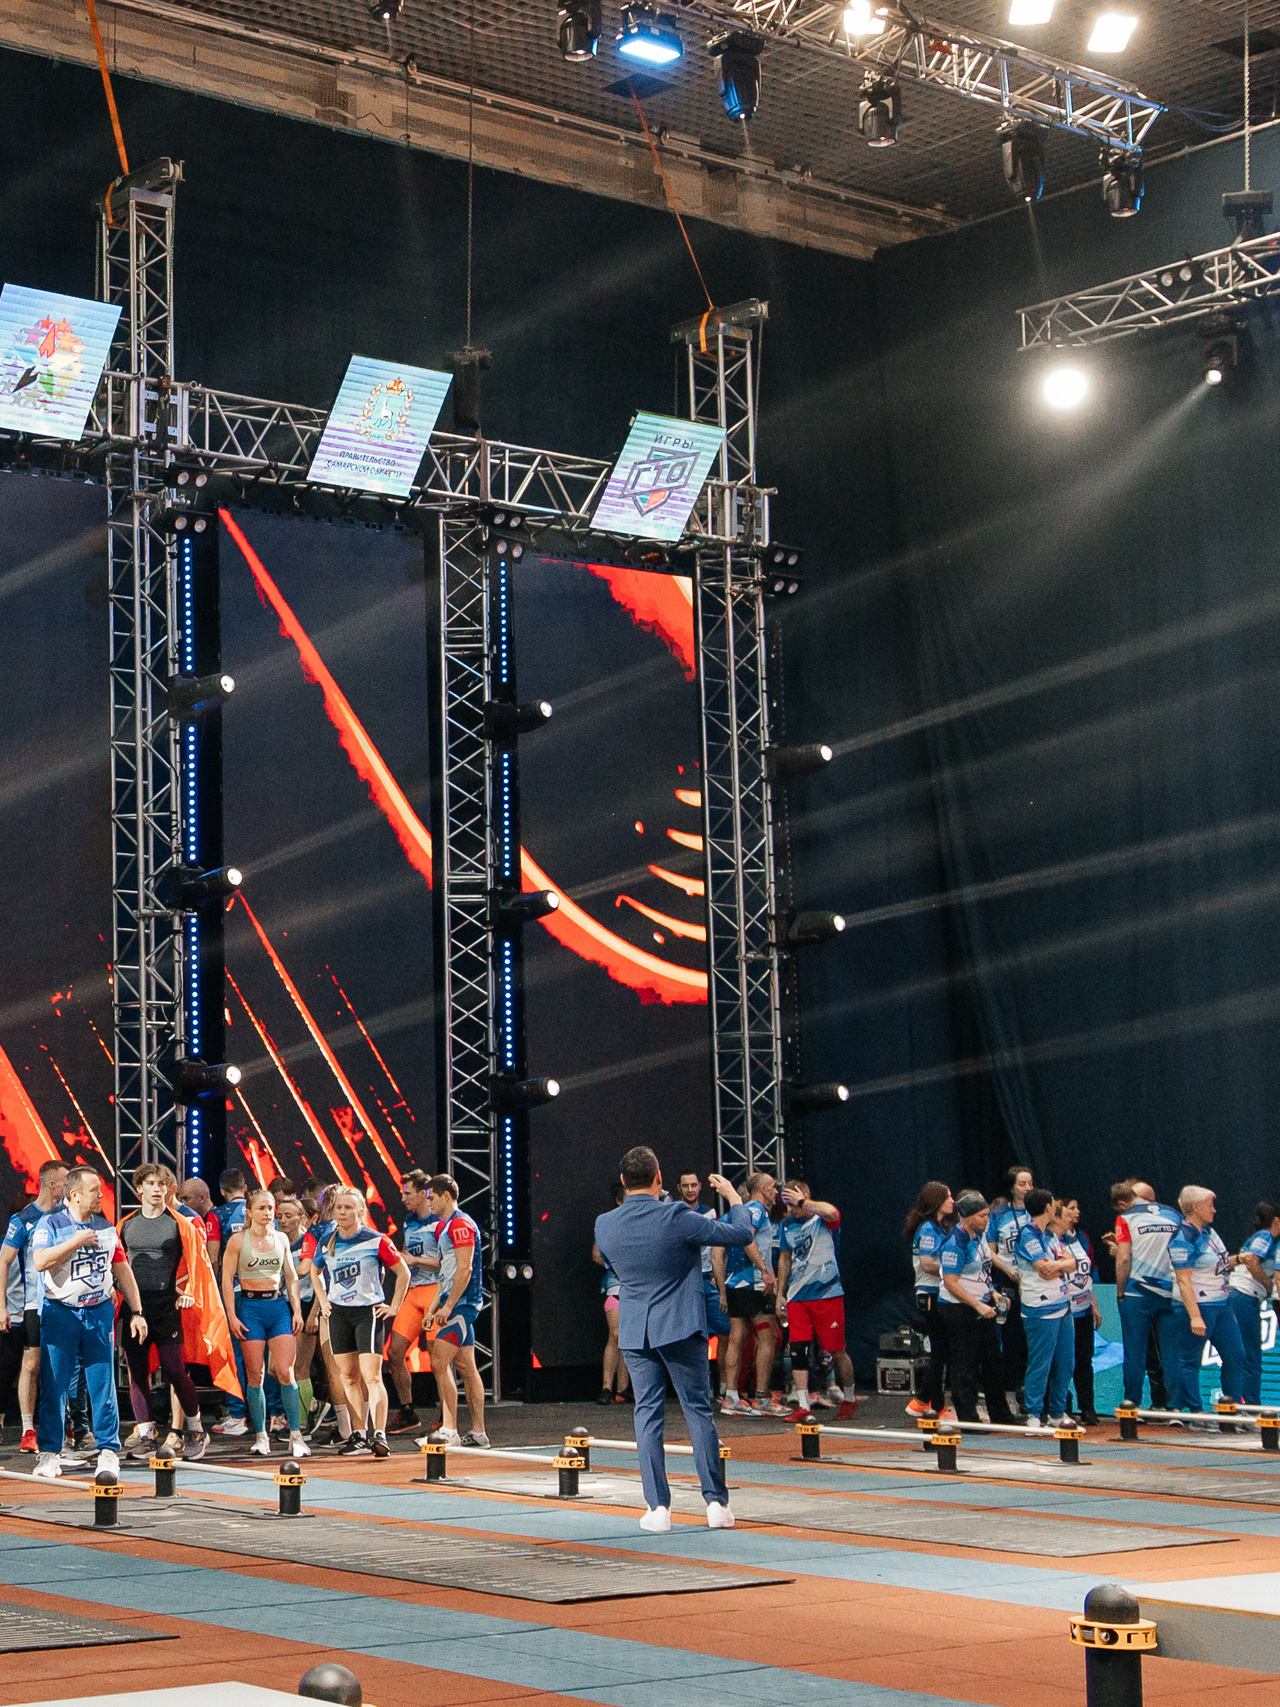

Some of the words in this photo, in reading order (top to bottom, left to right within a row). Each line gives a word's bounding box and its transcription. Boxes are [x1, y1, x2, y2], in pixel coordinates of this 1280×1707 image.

[653, 434, 694, 450] ИГРЫ
[339, 450, 396, 467] ПРАВИТЕЛЬСТВО
[630, 461, 687, 490] ГТО
[259, 1257, 280, 1266] asics
[334, 1264, 358, 1282] ГТО
